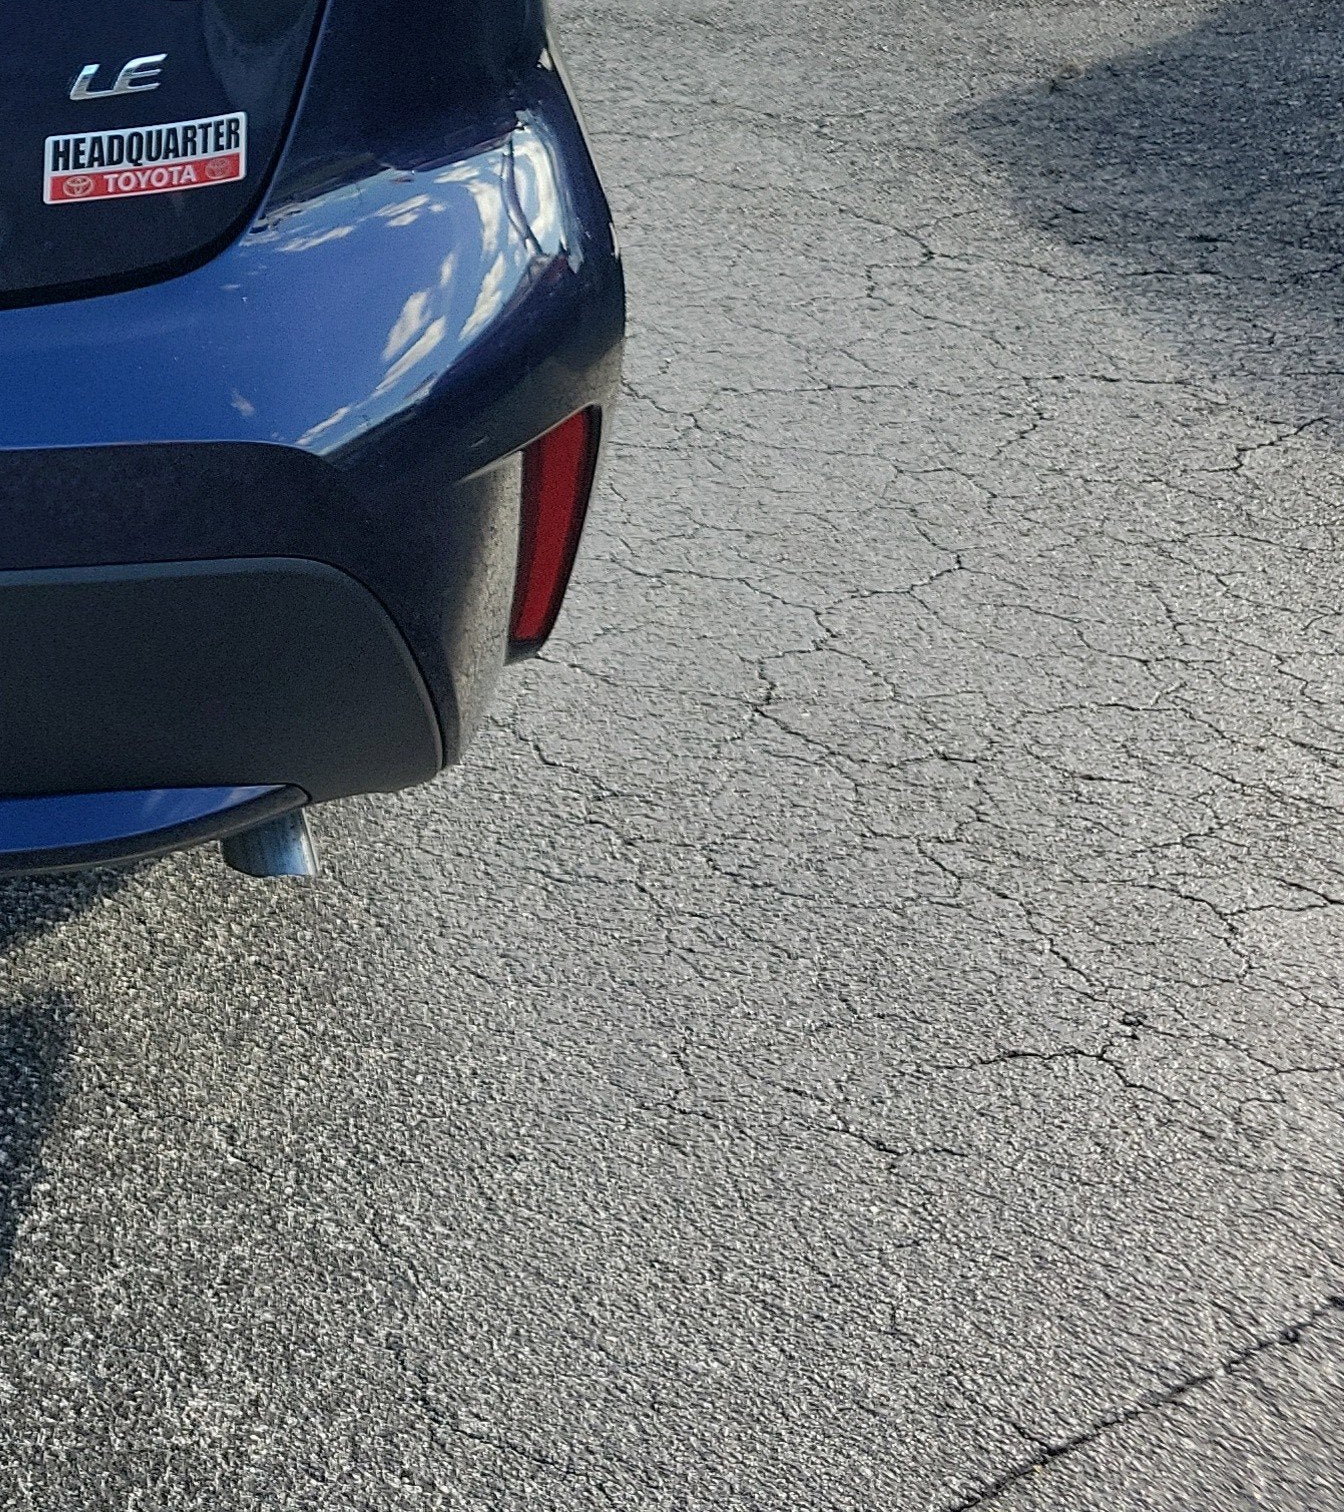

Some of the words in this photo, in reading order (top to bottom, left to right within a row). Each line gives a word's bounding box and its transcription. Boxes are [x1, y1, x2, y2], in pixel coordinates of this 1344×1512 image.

[70, 54, 168, 101] LE
[51, 117, 241, 172] HEADQUARTER
[103, 164, 197, 193] TOYOTA
